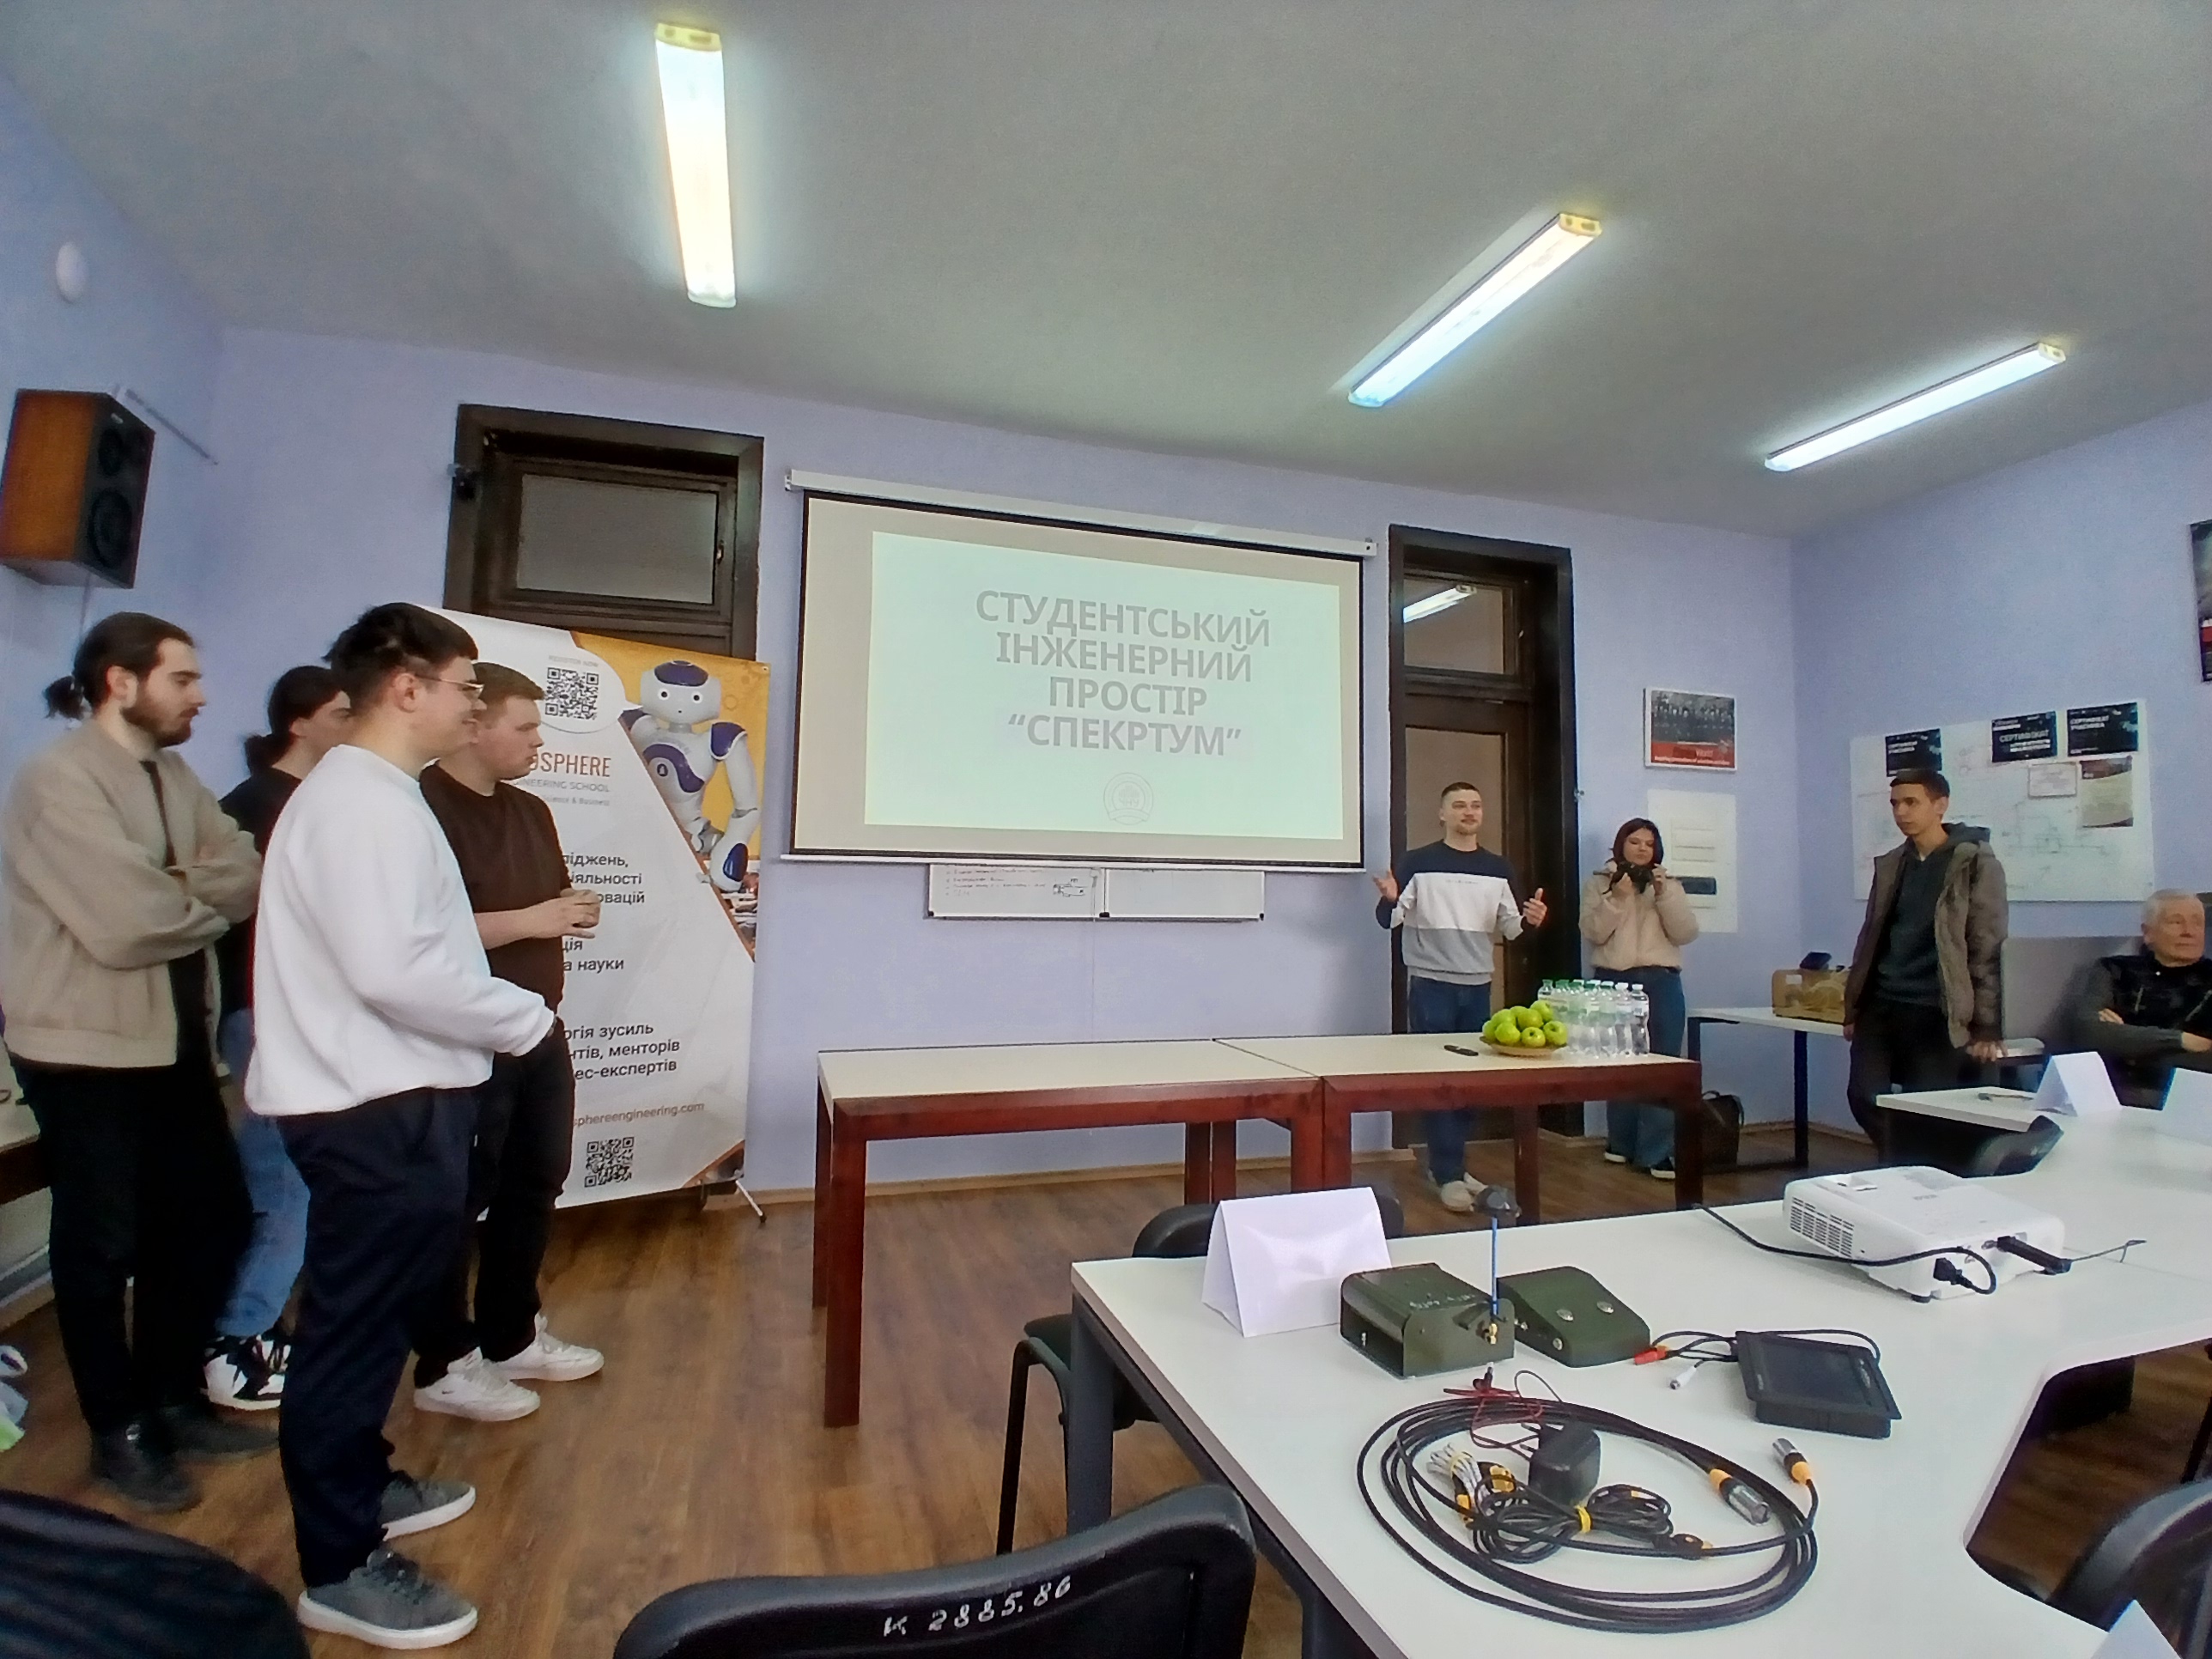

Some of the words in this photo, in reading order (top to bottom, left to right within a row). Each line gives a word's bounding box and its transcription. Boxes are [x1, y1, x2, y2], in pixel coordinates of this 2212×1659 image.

[976, 590, 1270, 647] СТУДЕНТСЬКИЙ
[996, 631, 1251, 682] ІНЖЕНЕРНИЙ
[1049, 676, 1207, 715] ПРОСТІР
[578, 959, 624, 974] науки
[599, 1024, 654, 1040] зусиль
[608, 1039, 680, 1057] менторів
